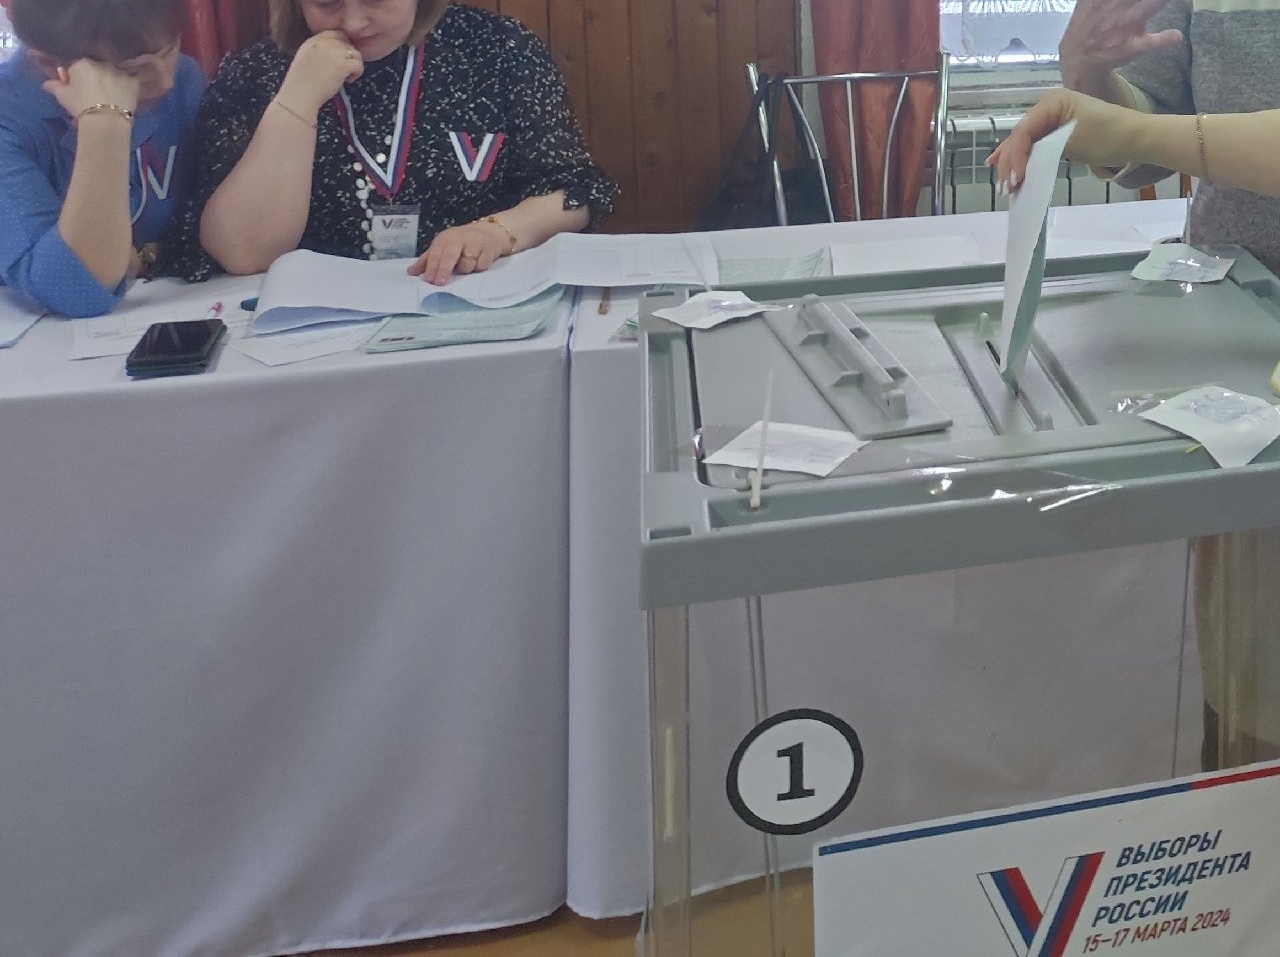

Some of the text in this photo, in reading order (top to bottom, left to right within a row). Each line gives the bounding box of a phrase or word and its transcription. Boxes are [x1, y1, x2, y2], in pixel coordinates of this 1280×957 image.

[775, 741, 816, 802] 1
[1116, 829, 1223, 869] ВЫБОРЫ
[1103, 851, 1253, 898] ПРЕЗИДЕНТА
[1091, 890, 1189, 928] РОССИИ
[1131, 915, 1188, 944] МАРТА
[1190, 908, 1232, 933] 2024
